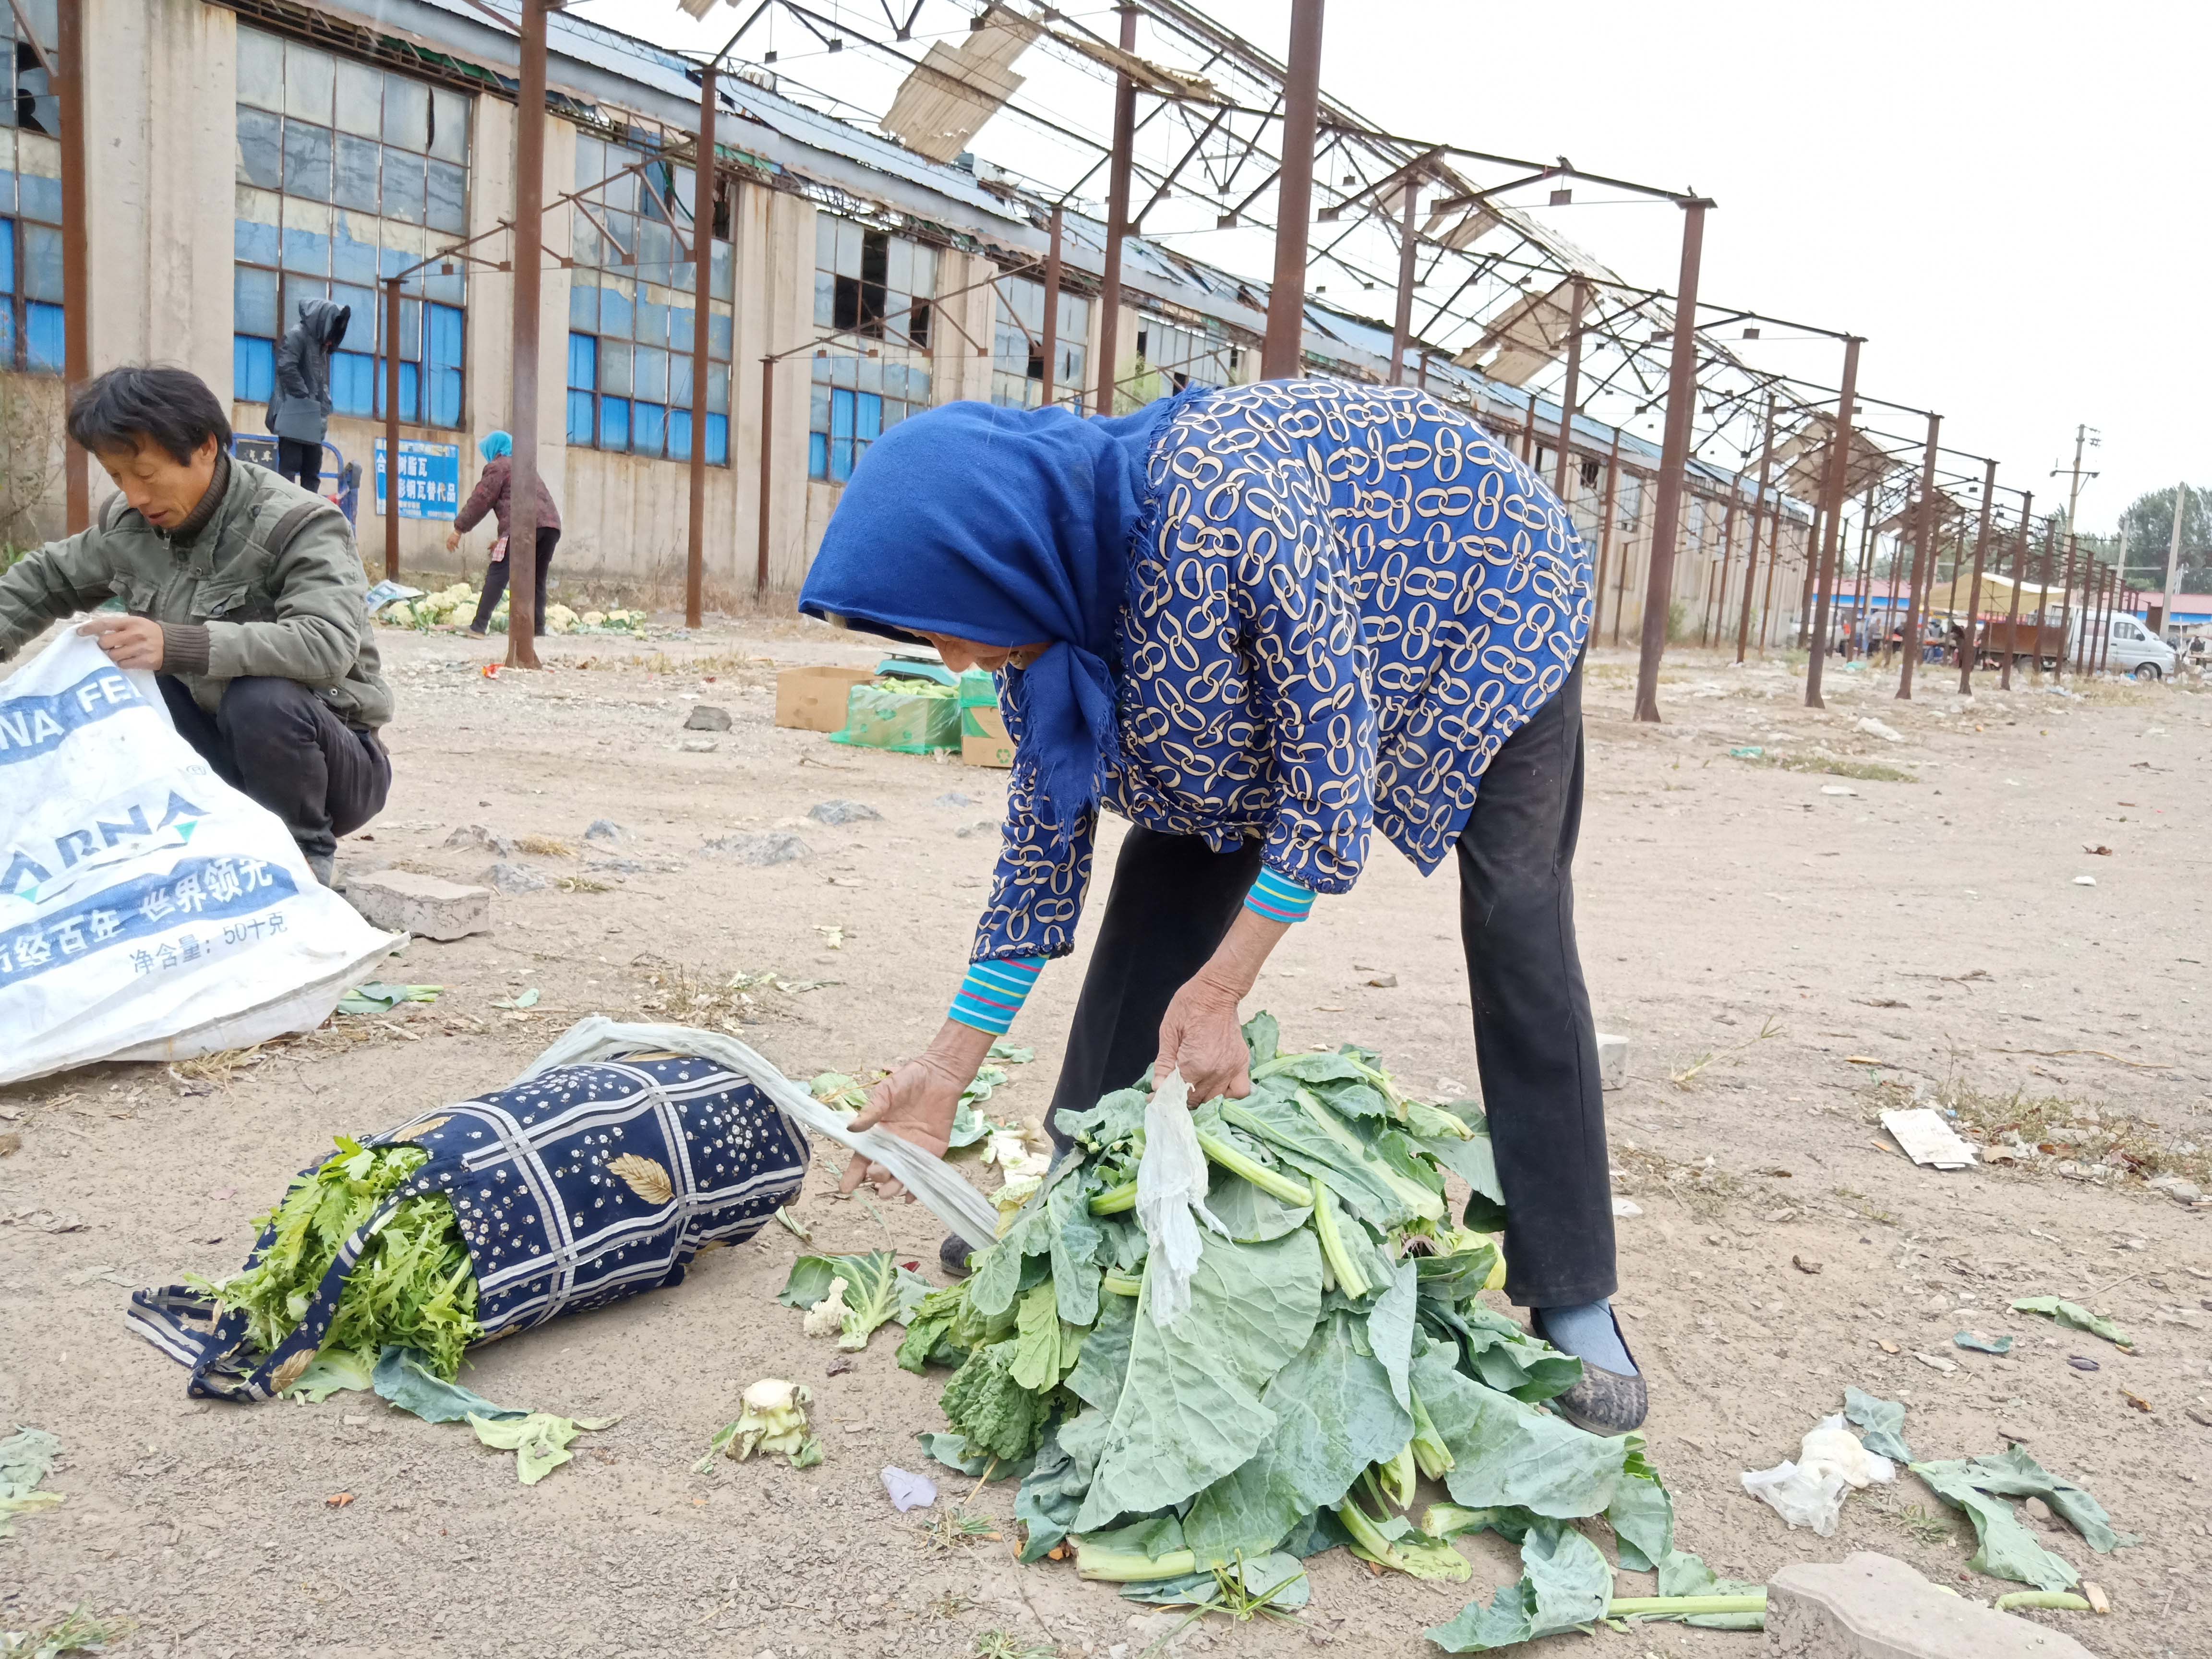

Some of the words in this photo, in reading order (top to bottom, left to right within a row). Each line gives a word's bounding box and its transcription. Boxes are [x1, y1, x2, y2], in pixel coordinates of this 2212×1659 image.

[376, 452, 427, 477] 合树脂瓦
[76, 675, 144, 713] FE
